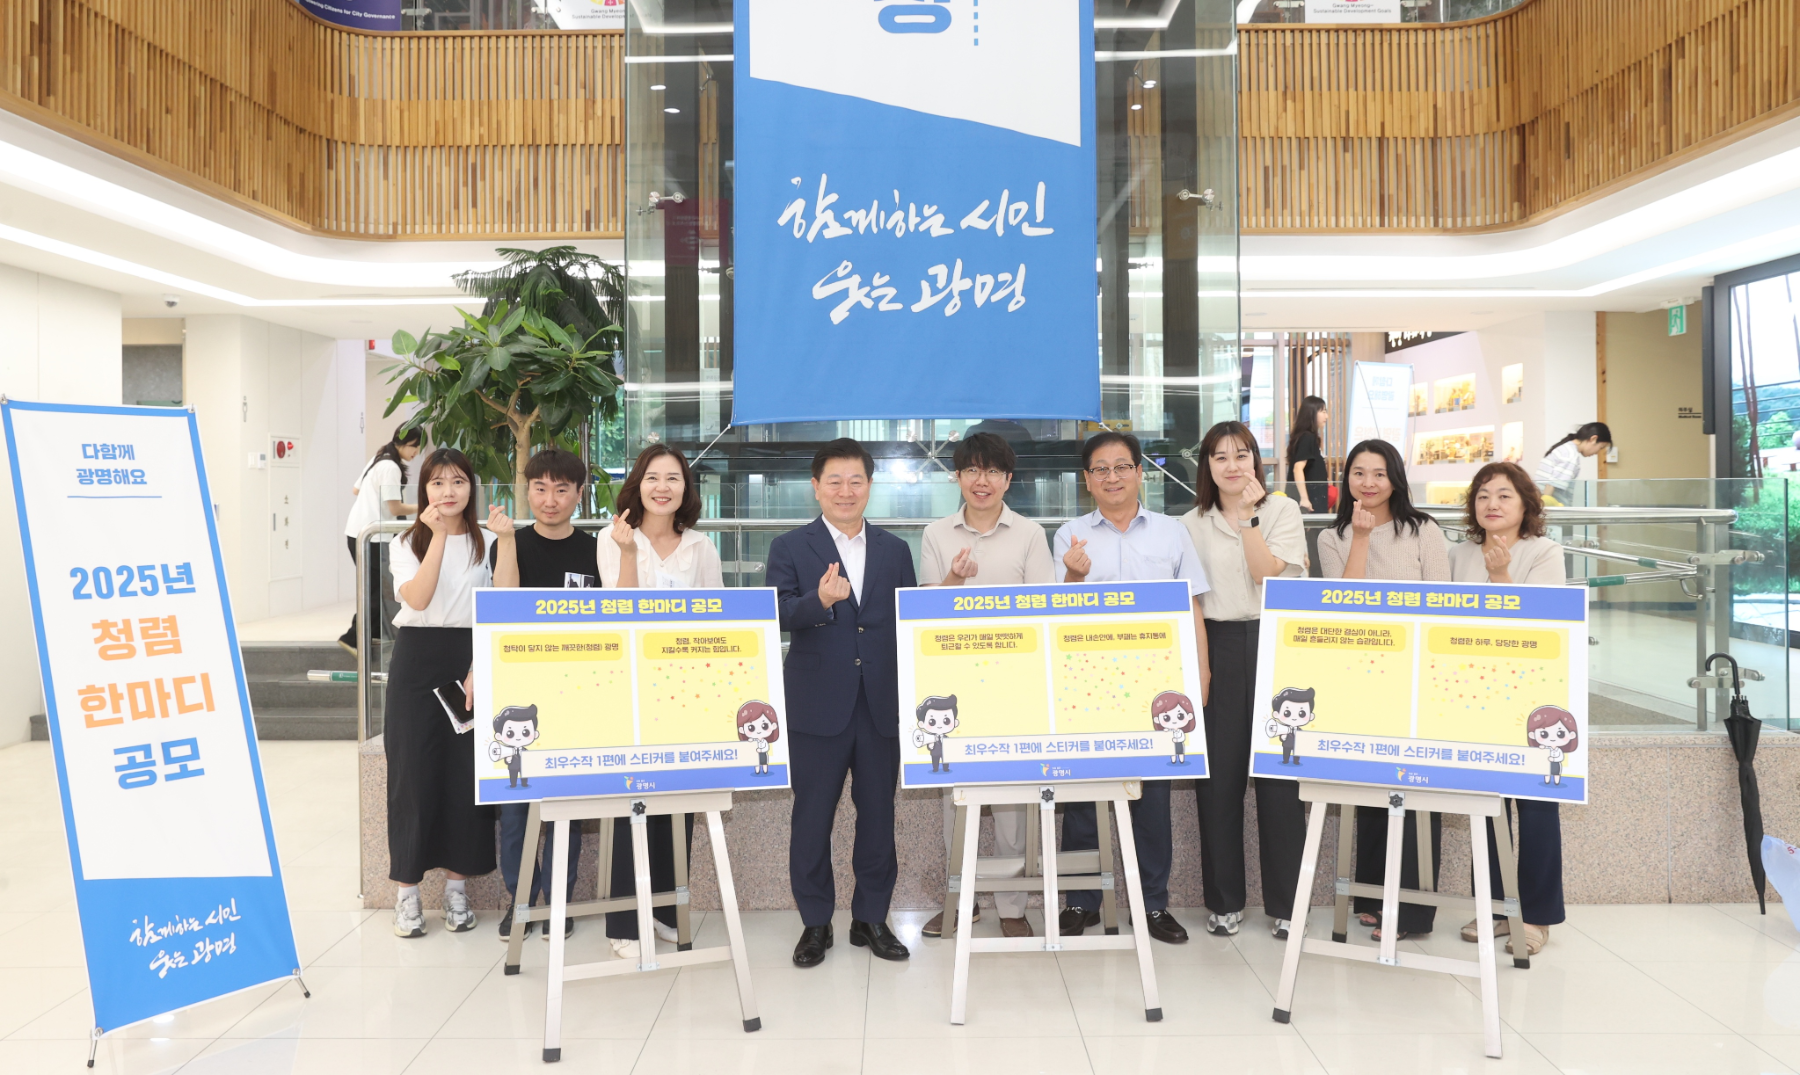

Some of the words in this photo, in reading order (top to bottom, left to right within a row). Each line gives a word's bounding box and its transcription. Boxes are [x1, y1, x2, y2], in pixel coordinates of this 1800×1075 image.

[324, 4, 342, 14] Citizens
[777, 173, 954, 243] 함께하는
[960, 181, 1054, 237] 시민
[812, 260, 903, 325] 웃는
[911, 258, 1026, 316] 광명
[82, 443, 135, 460] 다함께
[76, 469, 147, 485] 광명해요
[70, 562, 196, 600] 2025년
[536, 599, 596, 614] 2025년
[600, 599, 634, 614] 청렴
[638, 598, 686, 614] 한마디
[691, 598, 723, 613] 공모
[953, 595, 1010, 610] 2025년
[1015, 594, 1047, 609] 청렴
[1051, 593, 1099, 608] 한마디
[1104, 591, 1135, 606] 공모
[1321, 589, 1382, 605] 2025년
[1386, 592, 1421, 607] 청렴
[1426, 592, 1479, 608] 한마디
[1484, 594, 1520, 610] 공모
[92, 615, 182, 661] 청렴
[1310, 635, 1338, 644] 흔들리지
[1320, 627, 1342, 636] 대단한
[544, 644, 559, 652] 않는
[605, 643, 618, 651] 광명
[1450, 637, 1473, 645] 청렴한
[1521, 640, 1537, 648] 광명
[77, 672, 215, 728] 한마디
[965, 743, 1010, 756] 최우수작
[1014, 742, 1042, 754] 1편에
[1046, 740, 1090, 753] 스티커를
[1094, 738, 1153, 752] 붙여주세요!
[1318, 739, 1366, 754] 최우수작
[1370, 743, 1400, 756] 1편에
[1404, 745, 1453, 761] 스티커를
[1457, 749, 1525, 766] 붙여주세요!
[114, 737, 205, 790] 공모
[545, 755, 593, 769] 최우수작
[597, 754, 626, 766] 1편에
[630, 751, 675, 765] 스티커를
[679, 749, 738, 763] 붙여주세요!
[636, 782, 656, 790] 광명시
[1408, 776, 1428, 784] 광명시
[129, 915, 203, 947] 함께하는
[205, 898, 241, 925] 시민
[149, 950, 188, 979] 웃는
[191, 932, 236, 965] 광명
